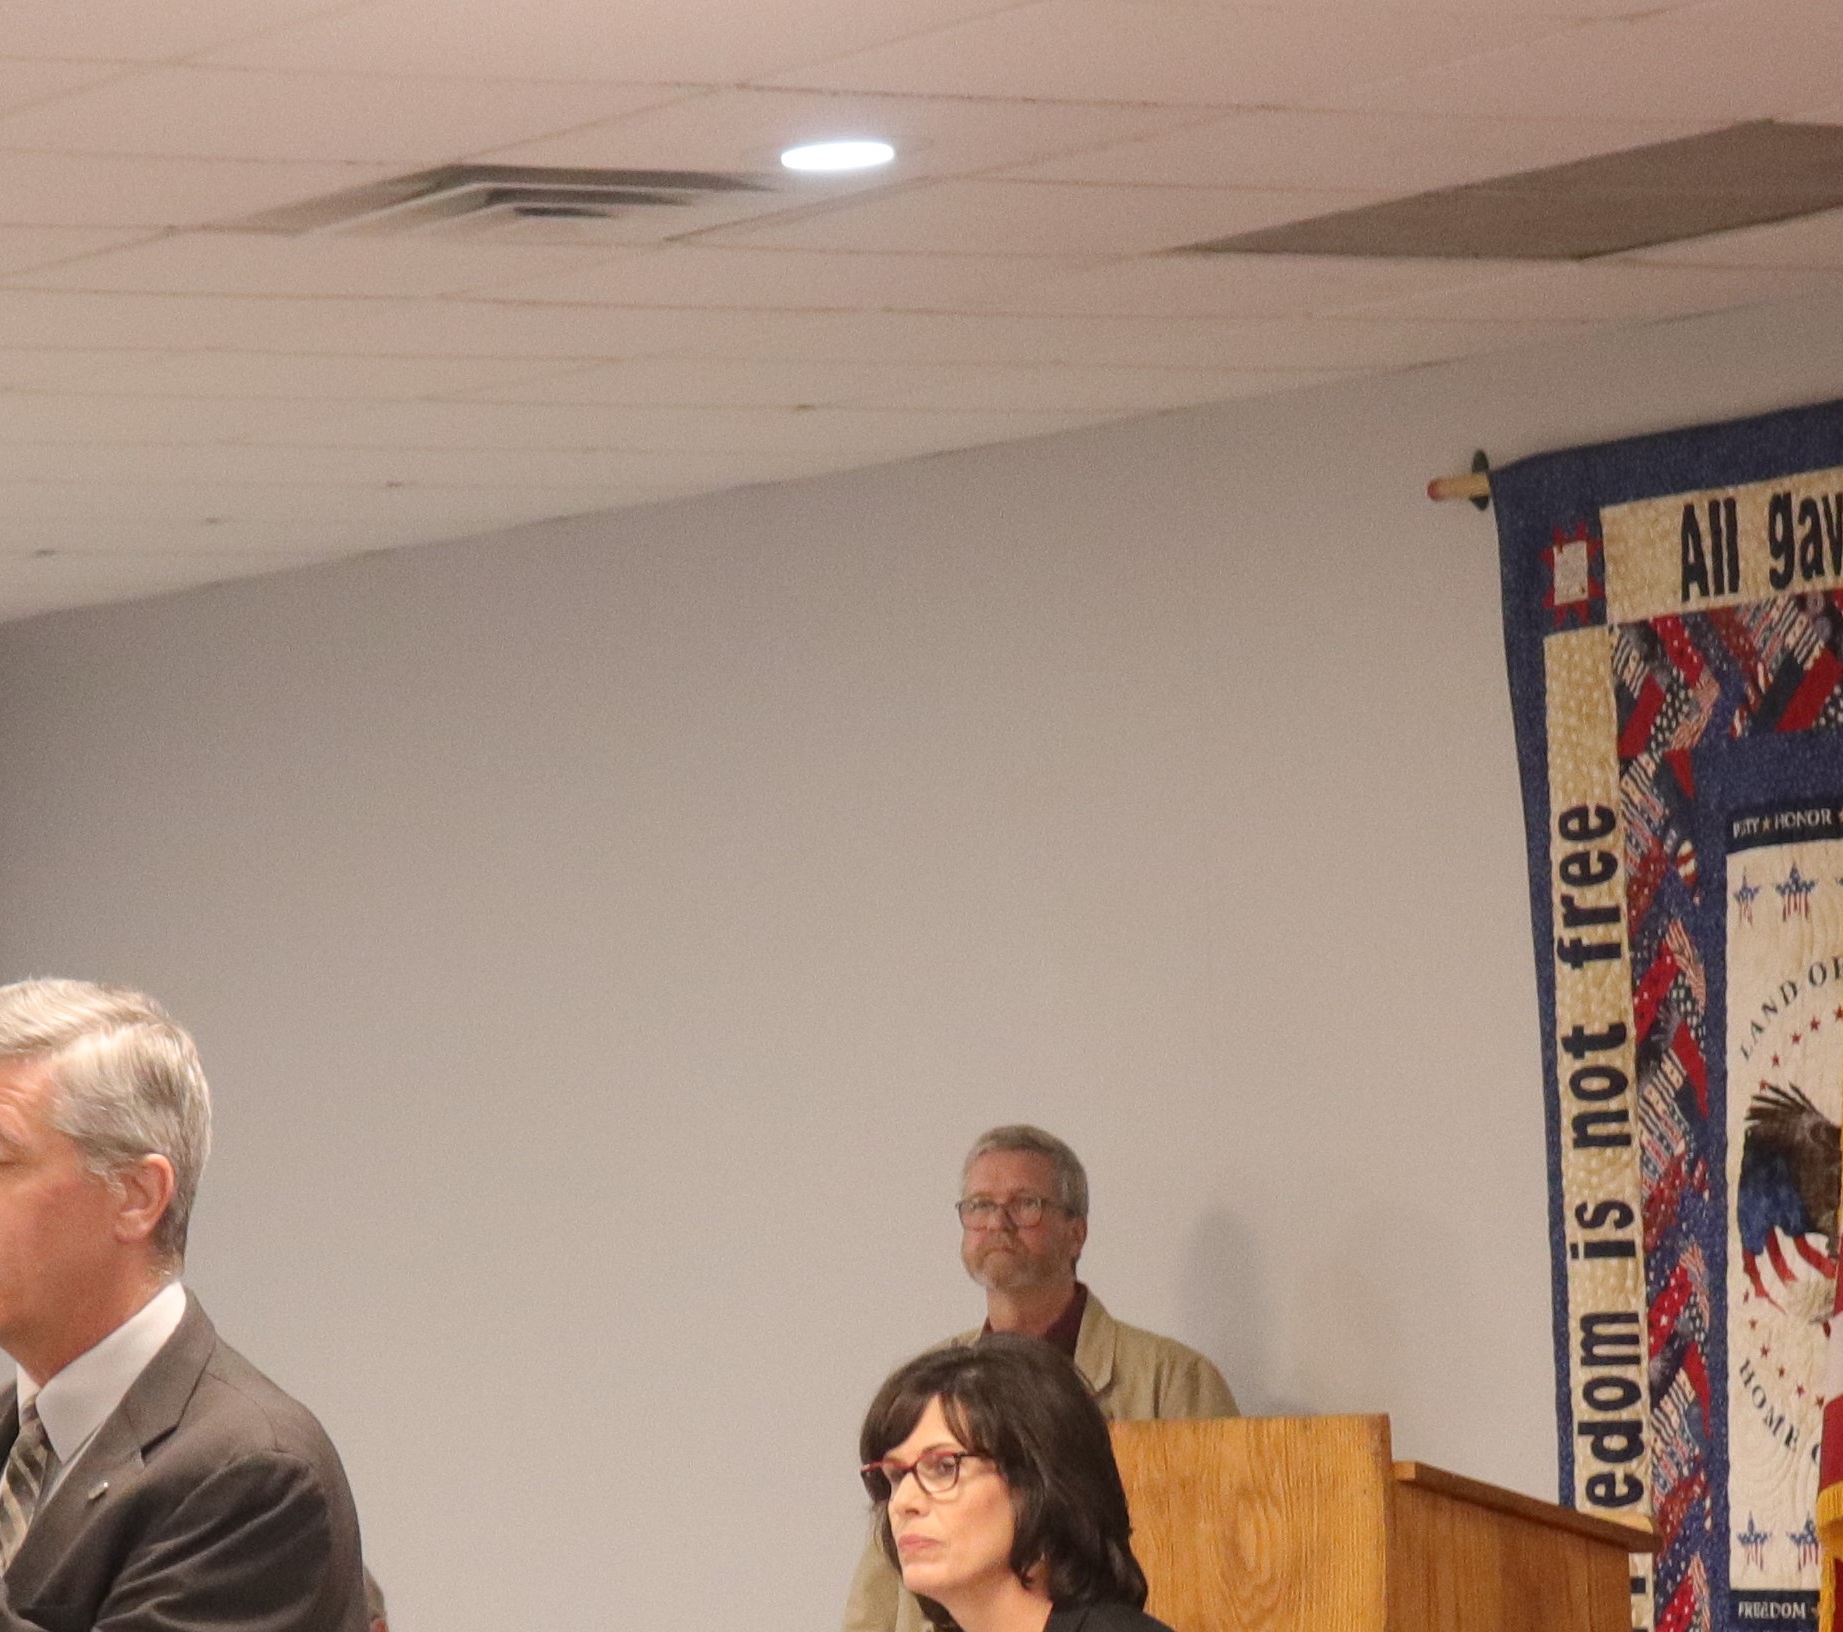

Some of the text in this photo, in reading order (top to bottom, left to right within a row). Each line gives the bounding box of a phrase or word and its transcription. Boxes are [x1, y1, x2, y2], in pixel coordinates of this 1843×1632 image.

[1680, 498, 1741, 602] All
[1774, 808, 1832, 831] HONOR
[1738, 978, 1800, 1061] LAND
[1558, 804, 1646, 1509] edom is not free
[1738, 1358, 1801, 1452] HOME
[1737, 1601, 1807, 1621] FREEDOM
